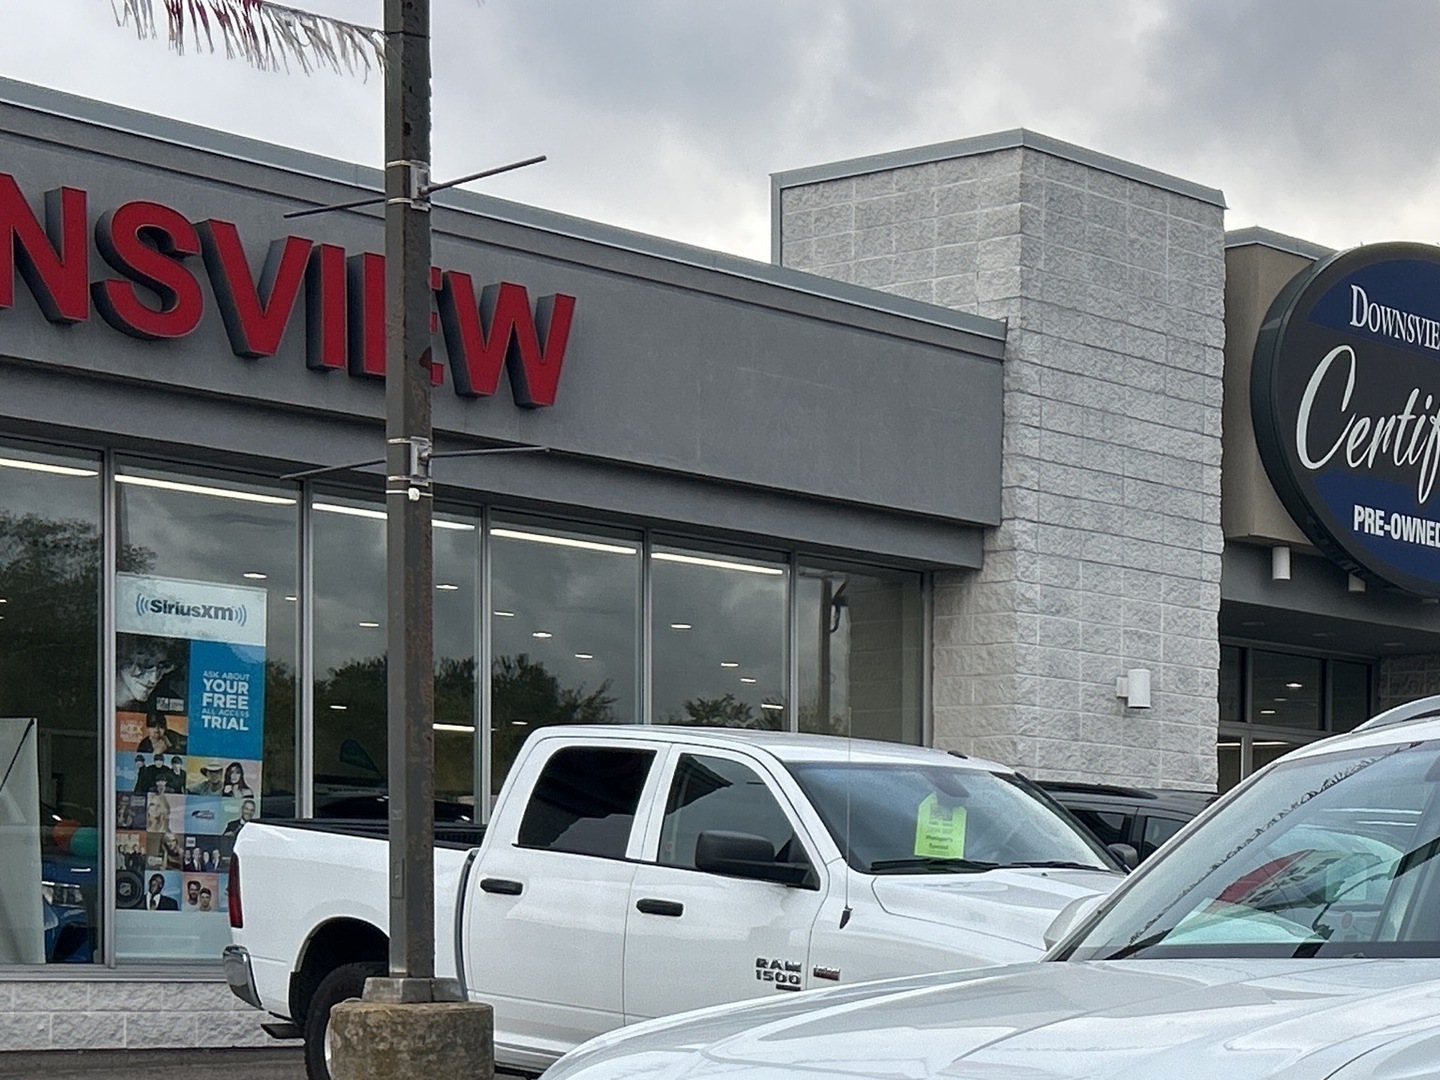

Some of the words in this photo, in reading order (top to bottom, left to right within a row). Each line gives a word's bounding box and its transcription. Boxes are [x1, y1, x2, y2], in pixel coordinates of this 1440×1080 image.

[203, 670, 219, 678] ASK
[221, 672, 249, 681] ABOUT
[203, 679, 249, 694] YOUR
[202, 693, 249, 710] FREE
[201, 714, 249, 731] TRIAL
[756, 957, 802, 972] RAM
[755, 970, 801, 985] 1500
